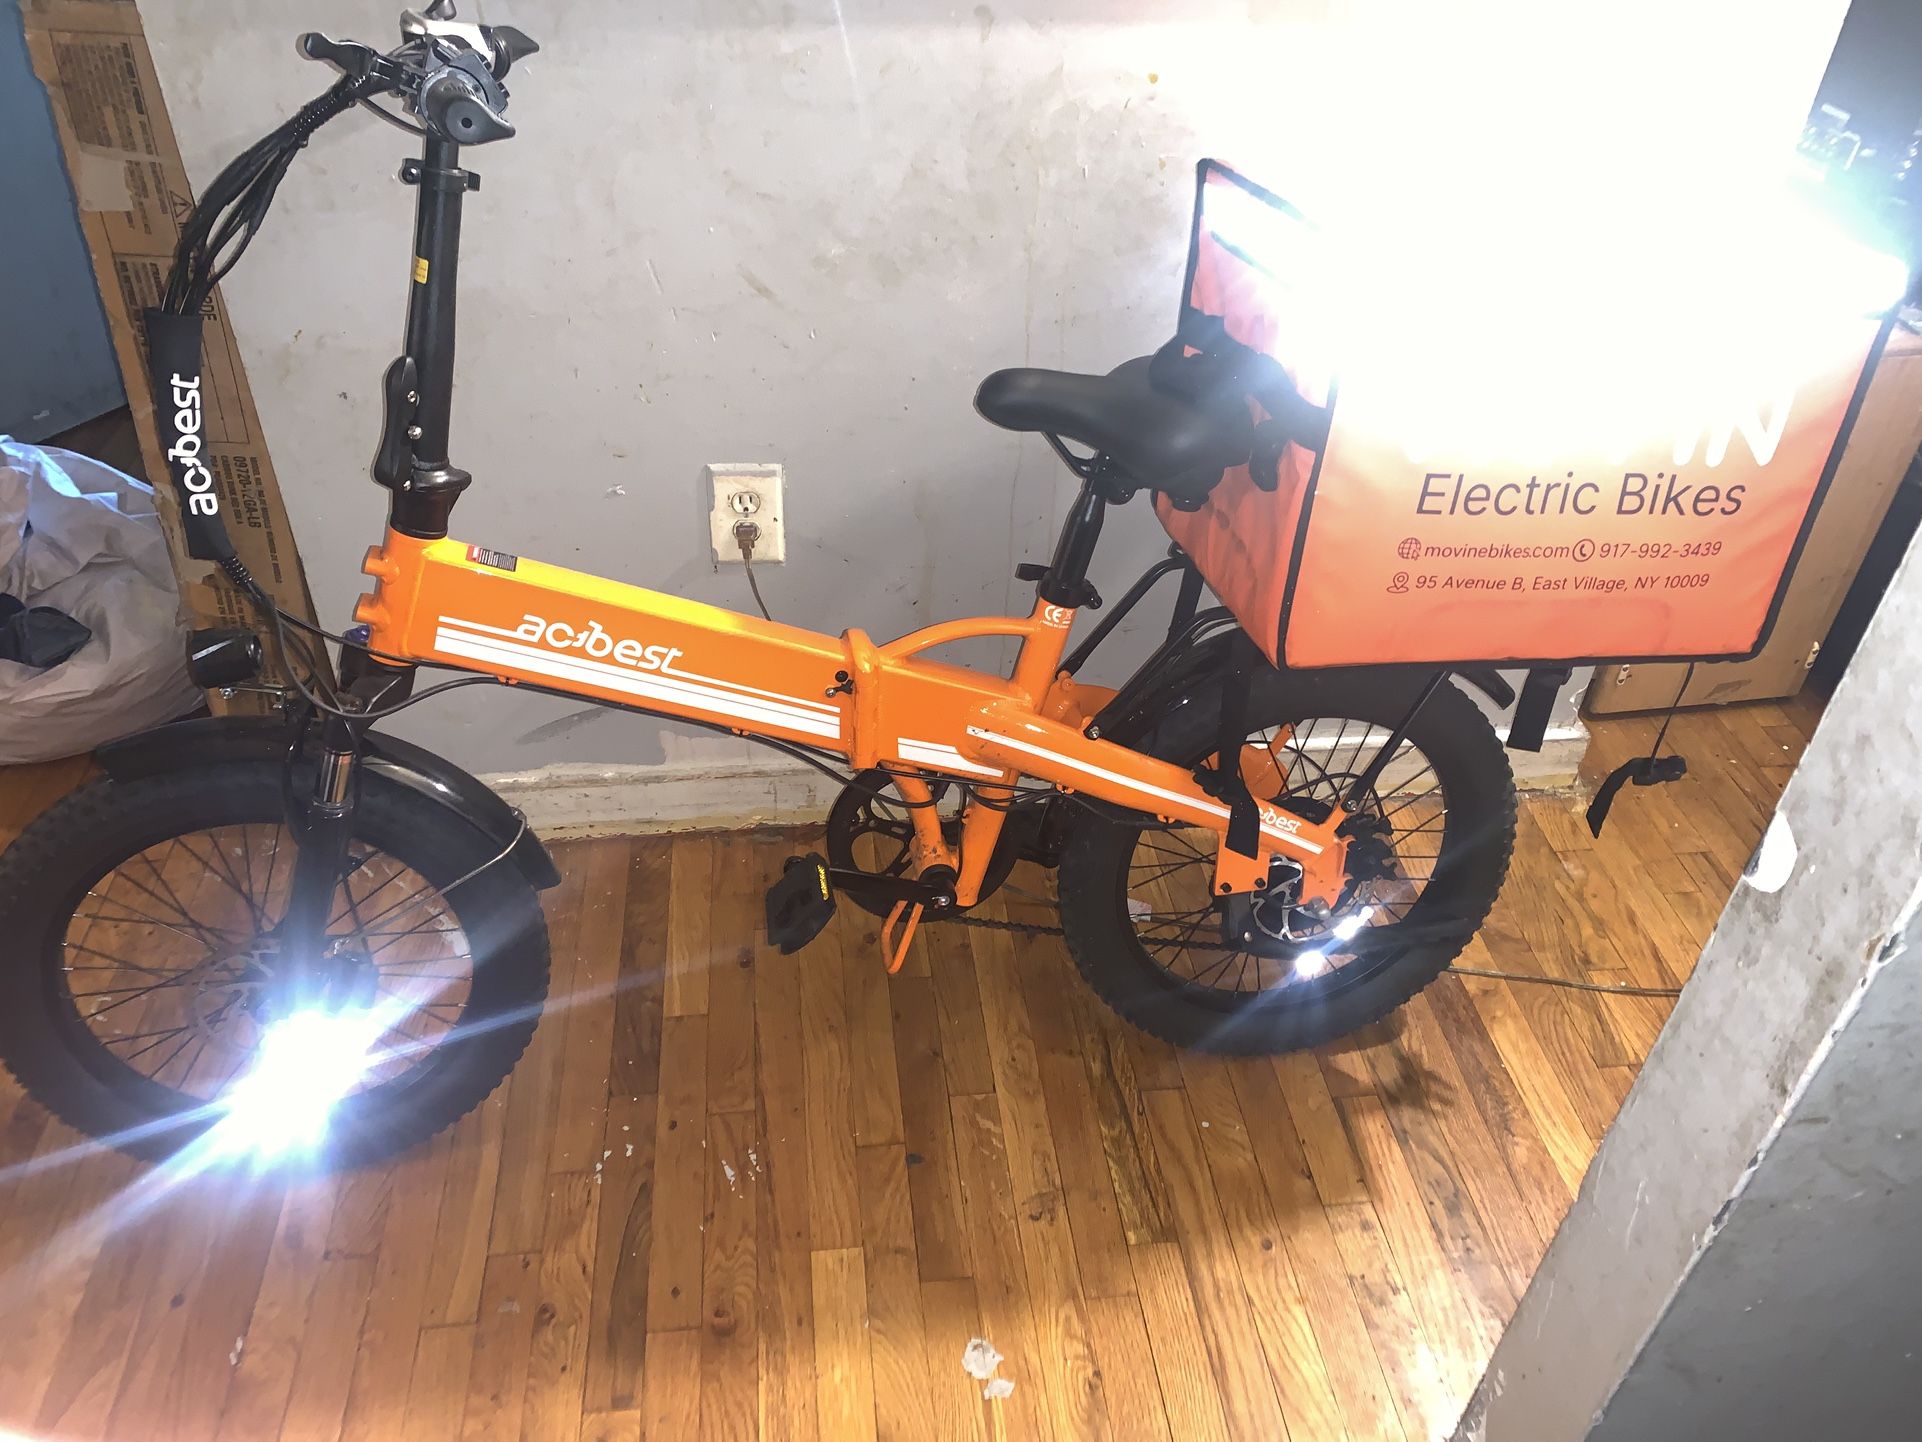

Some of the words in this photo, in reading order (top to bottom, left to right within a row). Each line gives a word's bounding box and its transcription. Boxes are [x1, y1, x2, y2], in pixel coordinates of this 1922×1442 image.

[1416, 471, 1600, 516] Electric
[1616, 472, 1746, 517] Bikes
[1424, 543, 1569, 559] movinebikes.com
[1600, 541, 1723, 559] 917-992-3439
[1415, 575, 1438, 589] 95
[1442, 576, 1506, 590] Avenue
[1511, 577, 1526, 593] B,
[1532, 576, 1568, 591] East
[1573, 576, 1628, 594] Village,
[1634, 575, 1660, 590] NY
[1664, 573, 1710, 589] 10009
